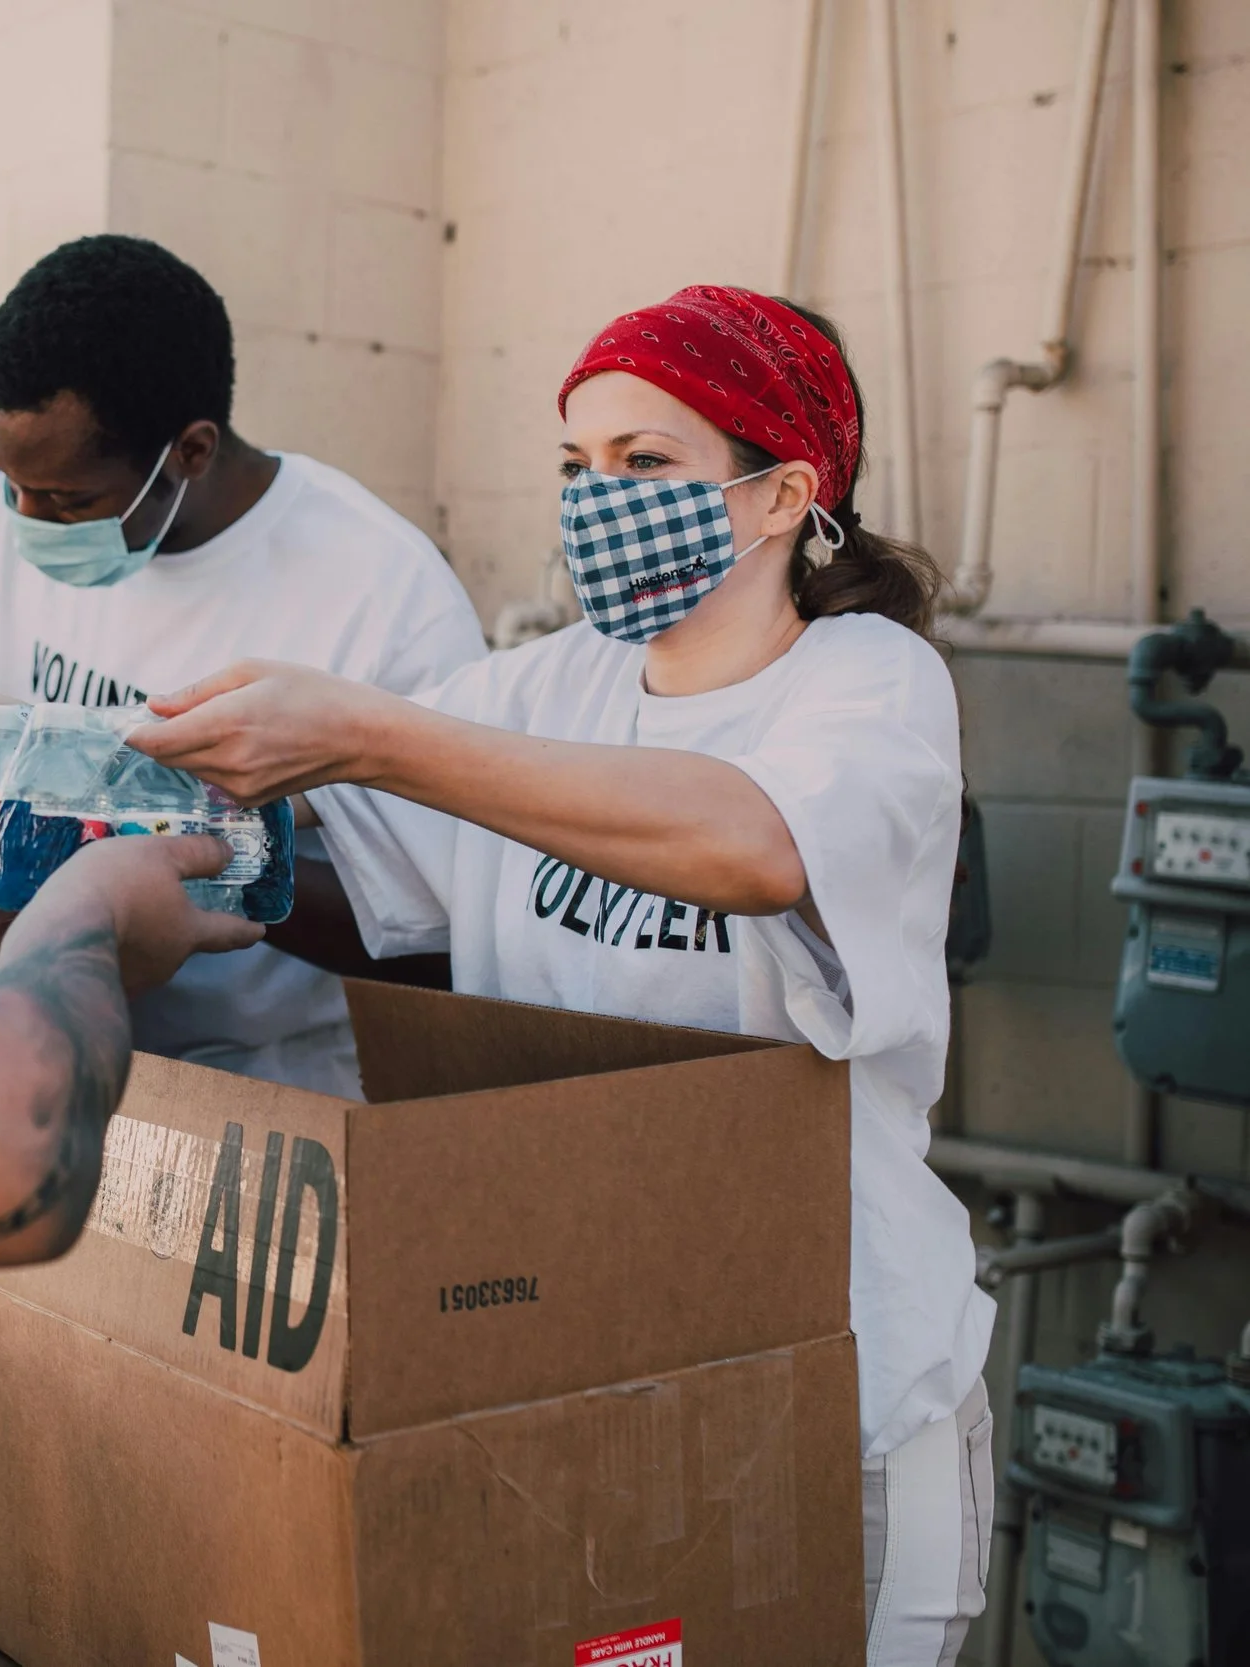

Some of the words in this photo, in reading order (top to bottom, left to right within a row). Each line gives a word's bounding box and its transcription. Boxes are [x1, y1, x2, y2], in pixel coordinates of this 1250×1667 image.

[629, 567, 688, 593] Hästens
[182, 1121, 338, 1373] AID
[440, 1276, 539, 1312] 76633051
[614, 1640, 634, 1654] WITH
[635, 1632, 666, 1649] HANDLE
[591, 1645, 613, 1660] CARE
